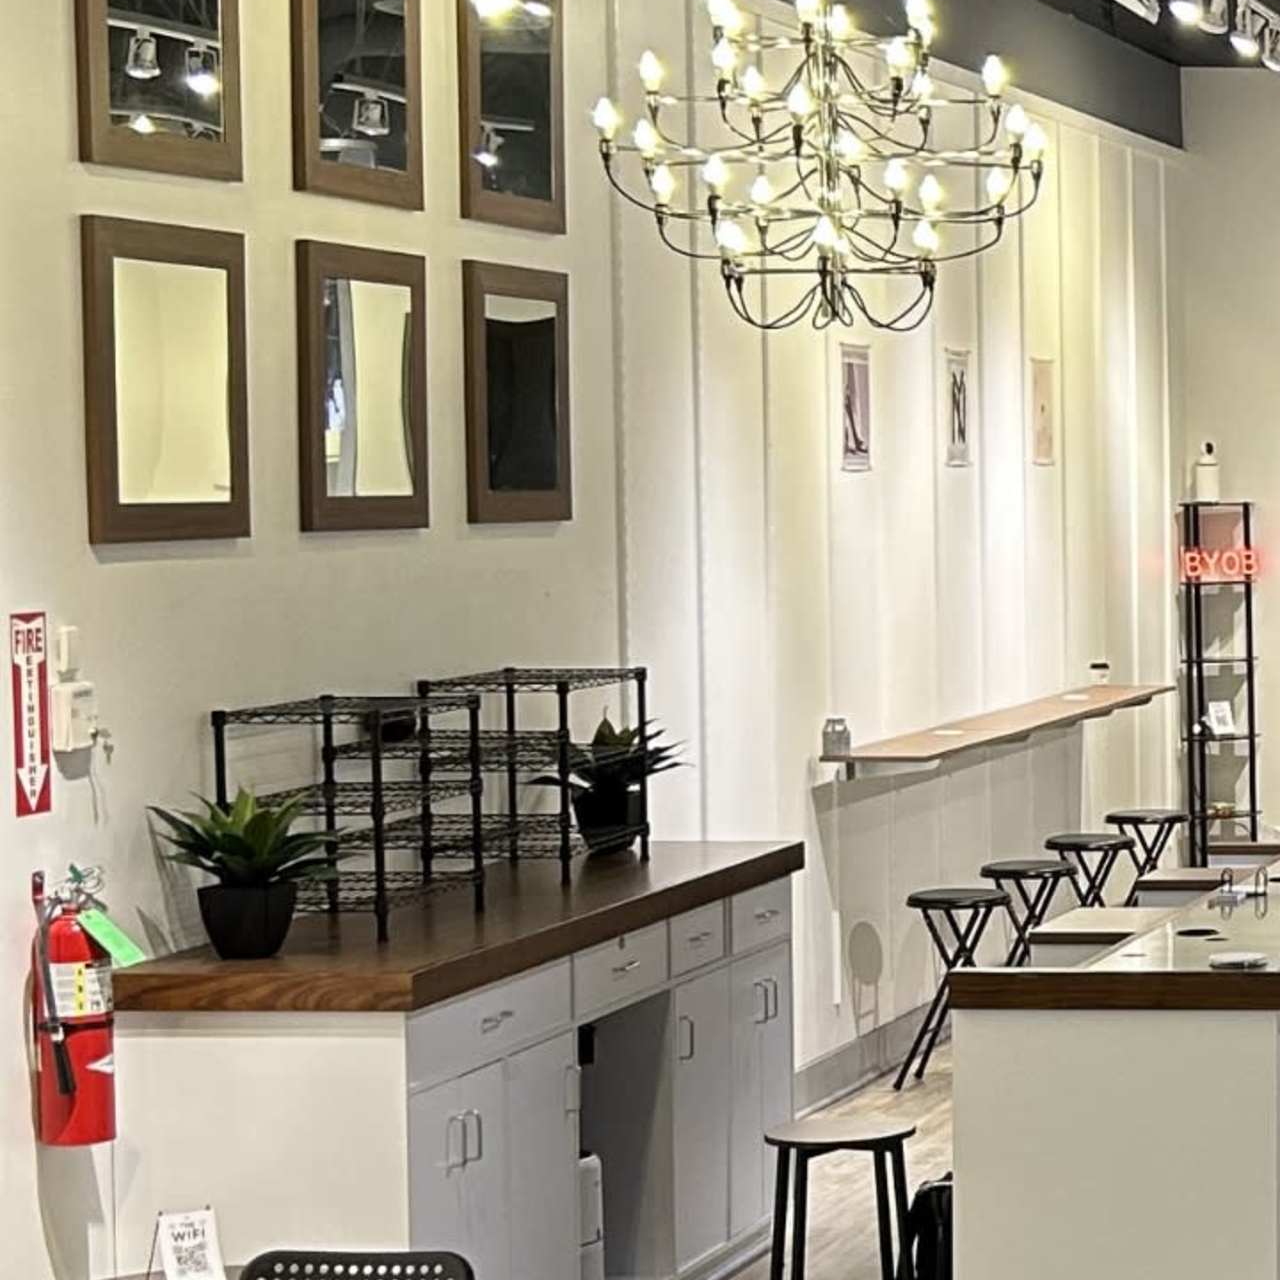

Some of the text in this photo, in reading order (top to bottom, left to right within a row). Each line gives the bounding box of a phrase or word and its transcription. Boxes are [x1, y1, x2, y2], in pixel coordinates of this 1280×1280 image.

[1184, 549, 1258, 577] BYOB
[14, 627, 43, 655] FIRE
[170, 1228, 206, 1242] WIFI
